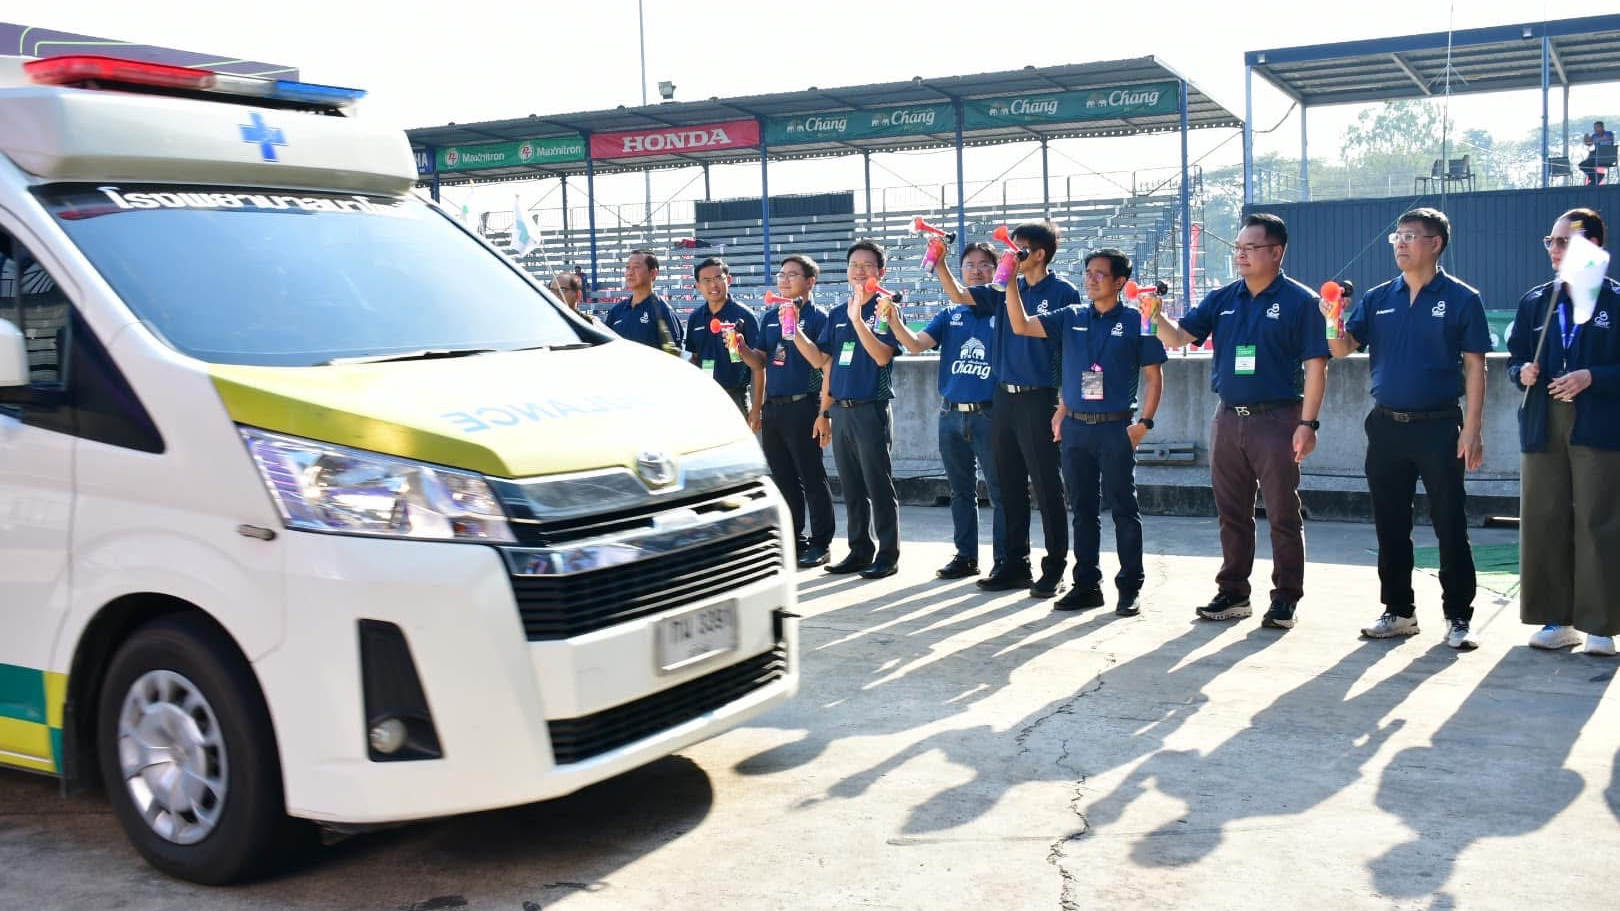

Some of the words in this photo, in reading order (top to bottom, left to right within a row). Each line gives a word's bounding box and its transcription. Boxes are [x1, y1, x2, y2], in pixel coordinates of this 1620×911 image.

[1108, 90, 1159, 107] Chang
[1010, 99, 1058, 115] Chang
[805, 117, 847, 132] Chang
[891, 110, 935, 126] Chang
[622, 128, 732, 153] HONDA
[951, 360, 991, 380] Chang
